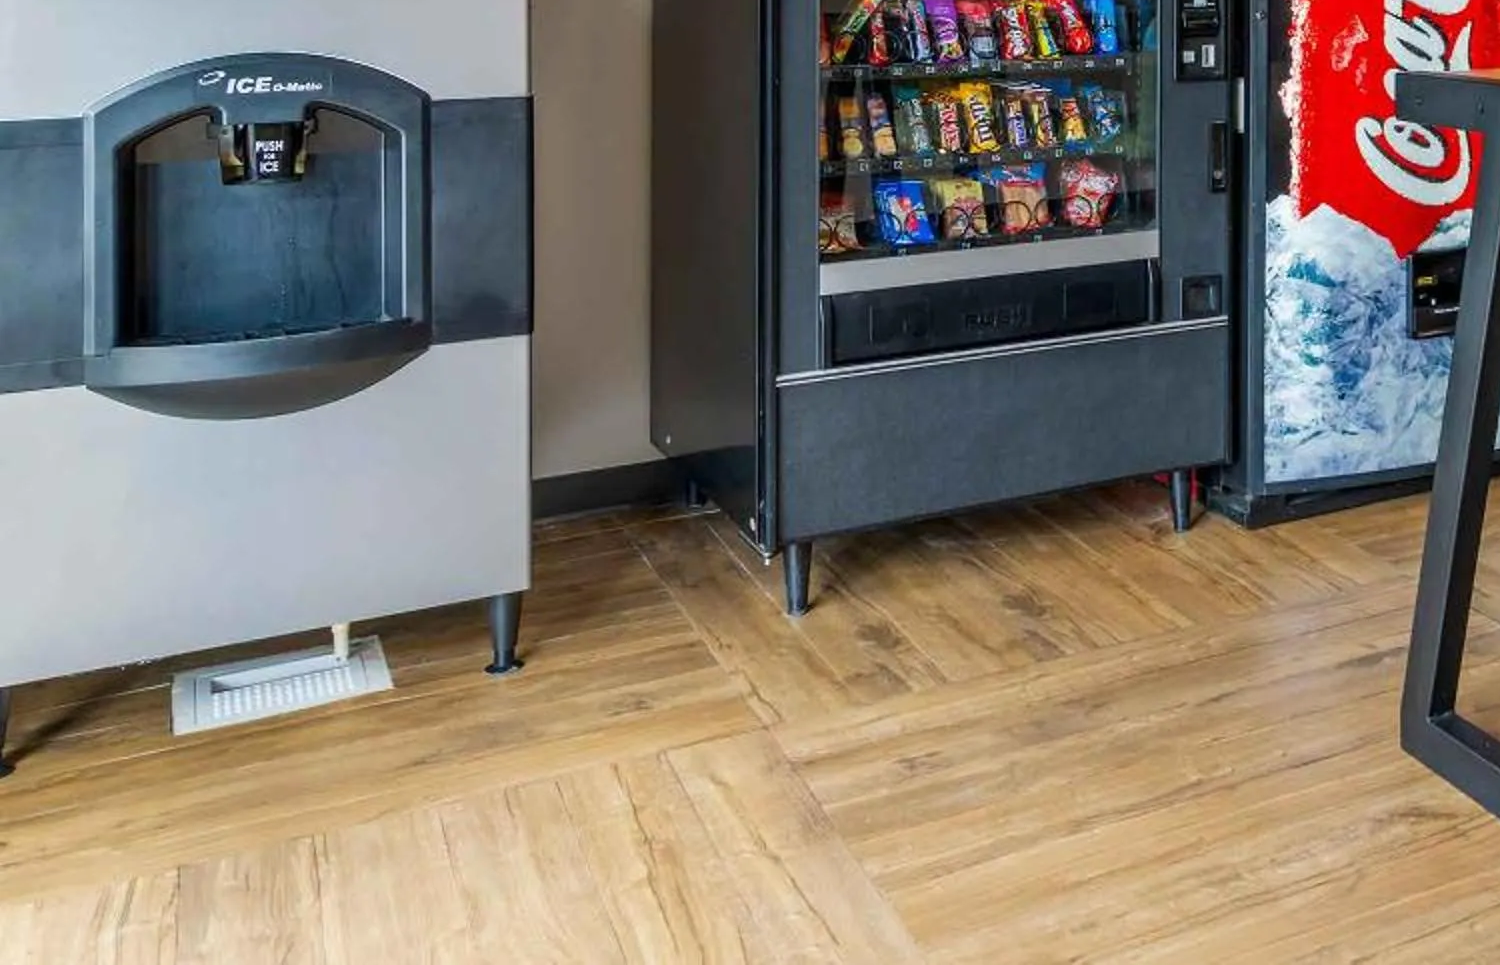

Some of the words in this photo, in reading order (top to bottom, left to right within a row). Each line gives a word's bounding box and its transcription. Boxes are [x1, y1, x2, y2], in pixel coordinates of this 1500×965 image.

[226, 76, 273, 95] ICE
[255, 140, 285, 152] PUSH
[259, 161, 279, 173] ICE
